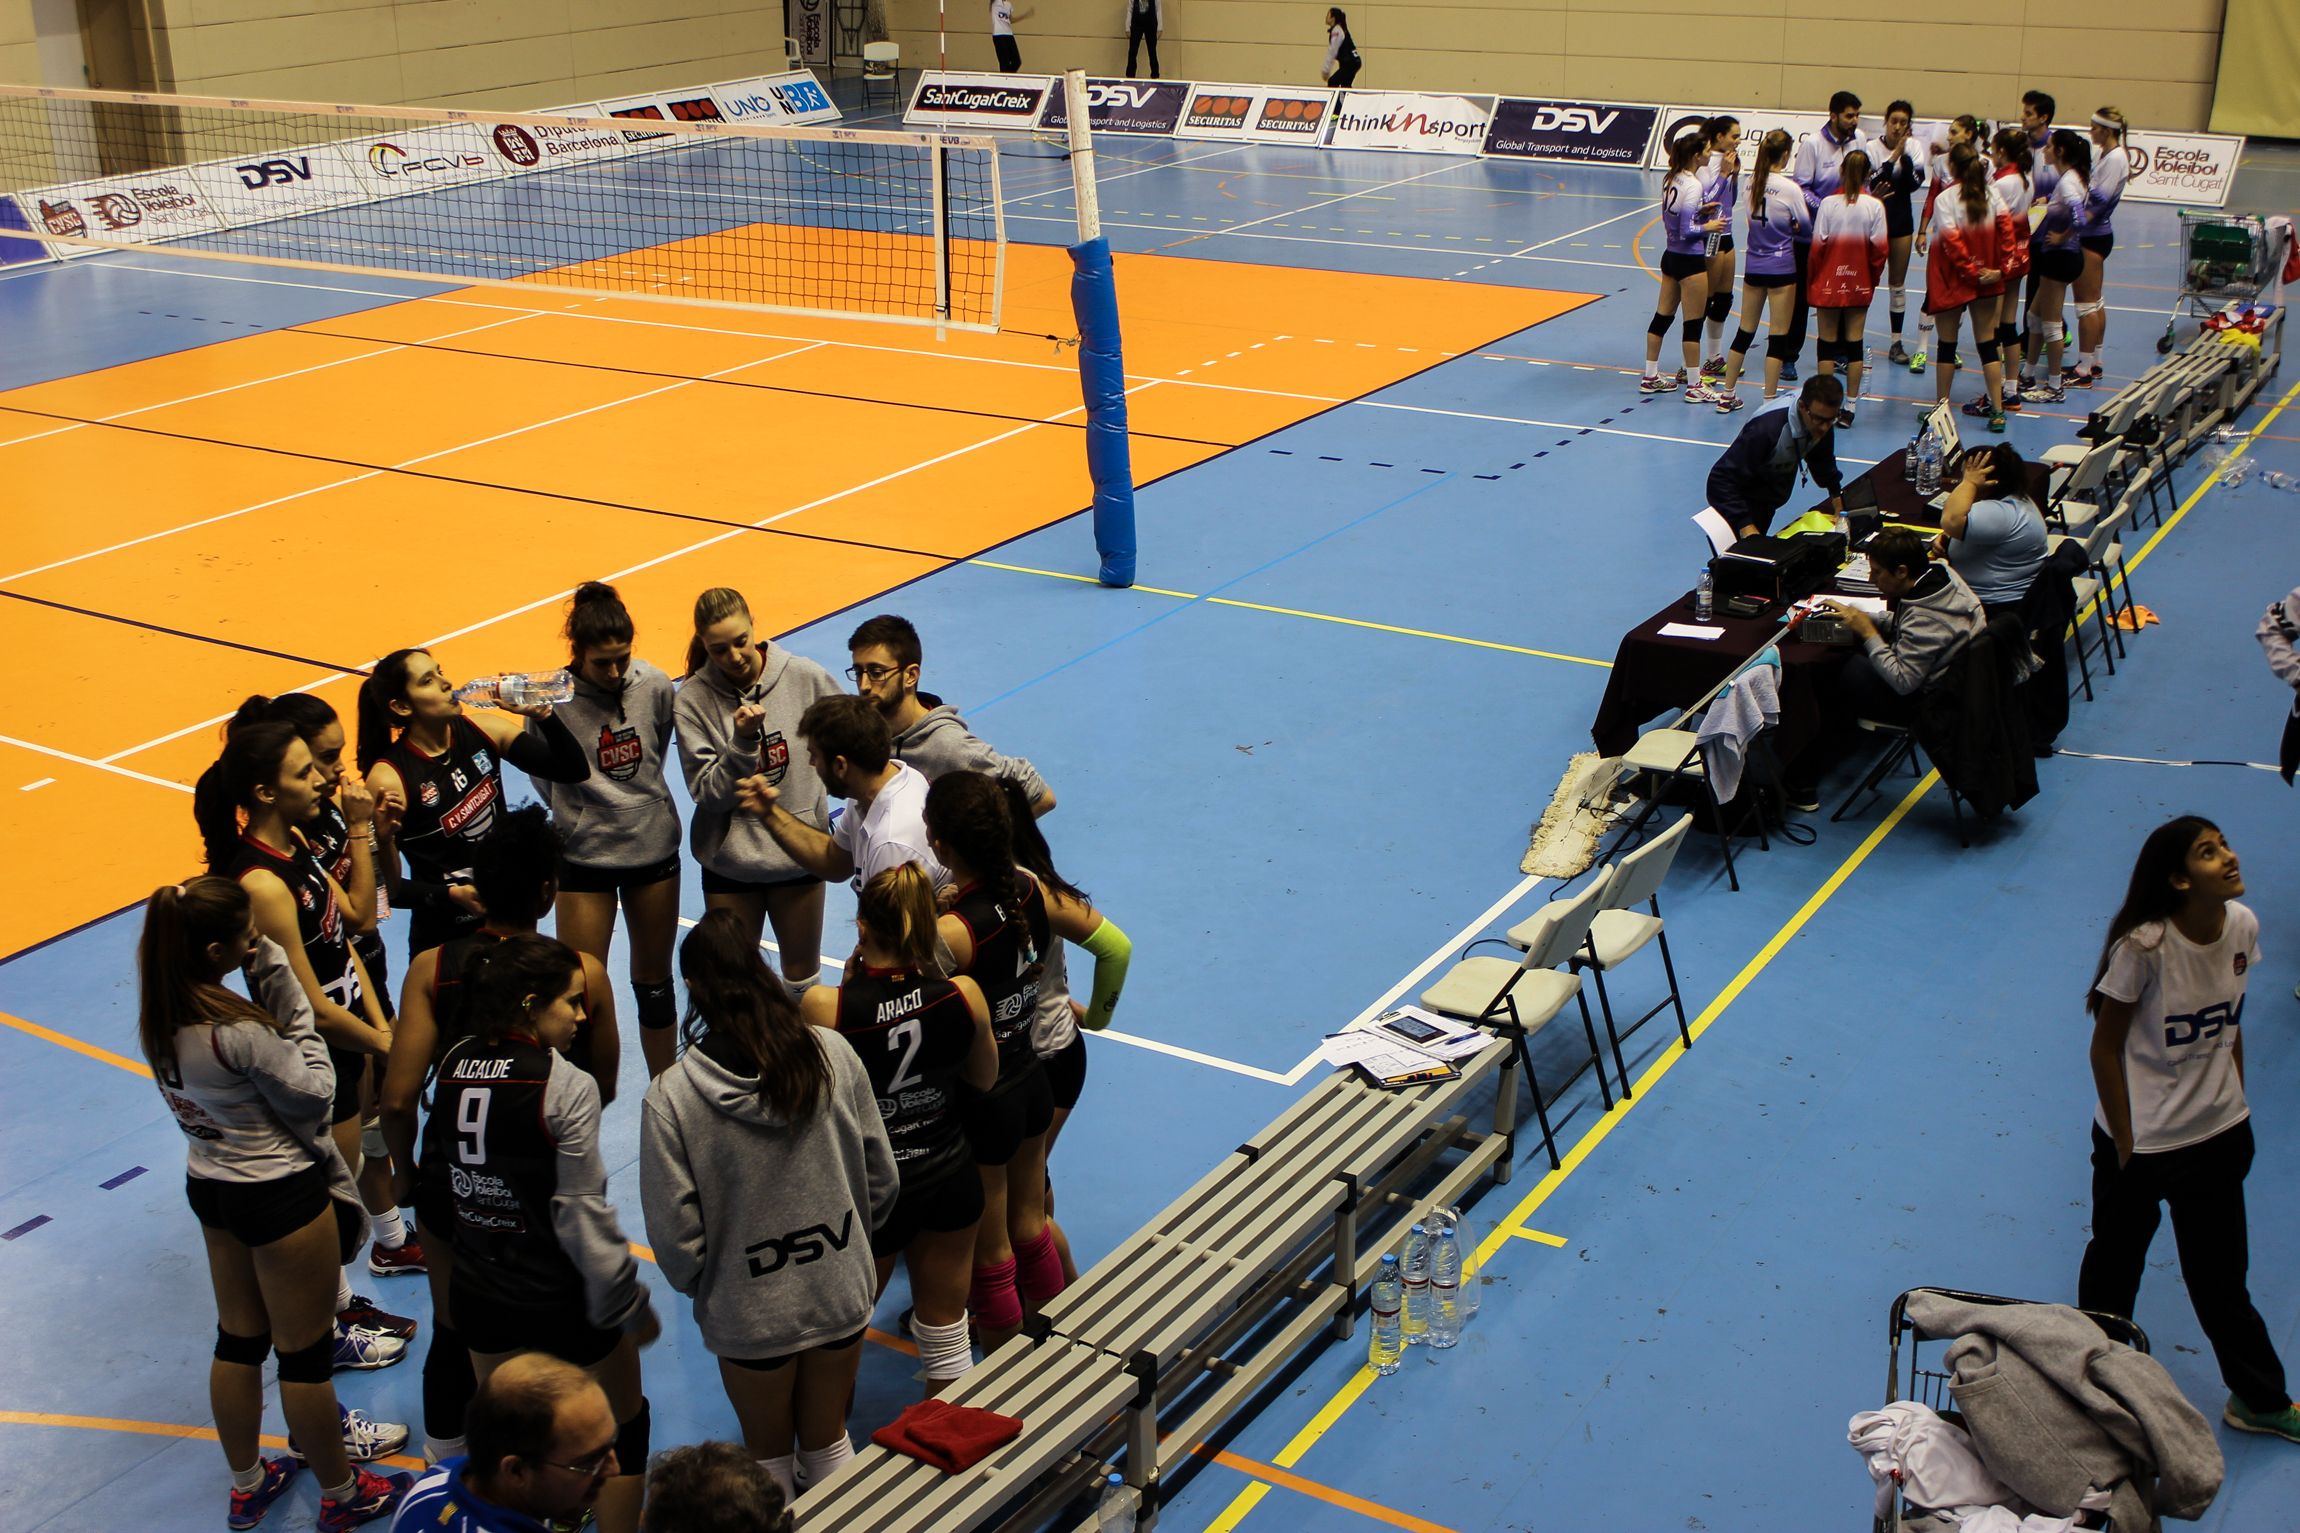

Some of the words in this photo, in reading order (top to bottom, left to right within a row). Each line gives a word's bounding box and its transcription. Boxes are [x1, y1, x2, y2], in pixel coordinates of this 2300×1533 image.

[1114, 119, 1130, 128] and
[1131, 119, 1167, 130] Logistics
[1188, 115, 1242, 127] SECURITAS
[1259, 119, 1317, 132] SECURITAS
[1531, 106, 1620, 135] DSV
[546, 134, 619, 156] Barcelona
[1495, 140, 1526, 150] Global
[1527, 142, 1570, 155] Transport
[1572, 145, 1589, 155] and
[1591, 148, 1633, 159] Logistics
[2154, 146, 2210, 162] Escola
[235, 156, 312, 190] DSV
[2153, 159, 2219, 176] Voleibol
[132, 184, 179, 201] Escola
[2146, 171, 2180, 187] Sant
[2180, 175, 2224, 193] Cugat
[140, 193, 197, 212] Voleibol
[1751, 197, 1769, 228] 4
[600, 741, 642, 768] CVSC
[2164, 992, 2245, 1048] DSV
[887, 1018, 923, 1094] 2
[452, 1059, 514, 1079] ALCALDE
[457, 1087, 491, 1165] 9
[745, 1209, 853, 1279] DSV
